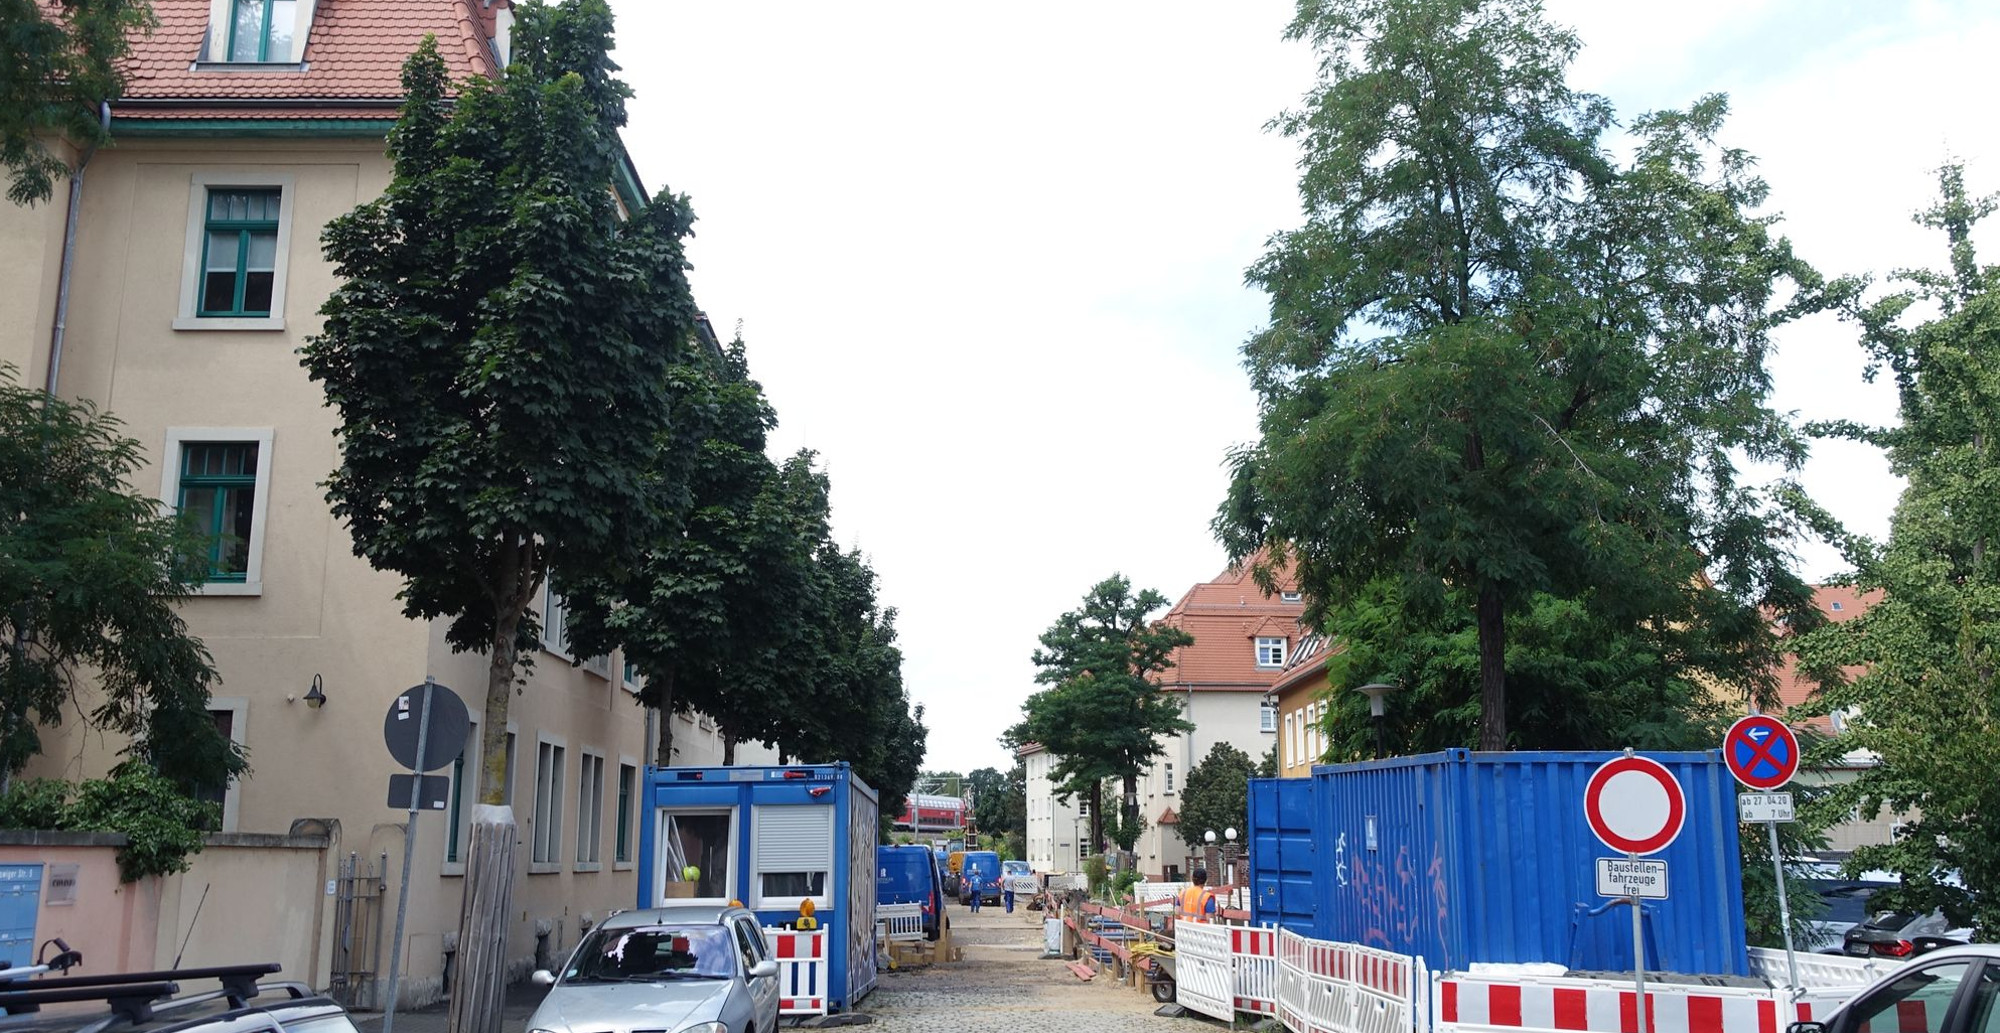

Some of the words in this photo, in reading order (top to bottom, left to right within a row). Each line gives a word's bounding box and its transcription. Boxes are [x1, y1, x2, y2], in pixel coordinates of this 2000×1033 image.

[1742, 797, 1751, 806] ab
[1744, 809, 1753, 818] ab
[1771, 809, 1776, 818] 7
[1778, 809, 1790, 818] Uhr
[1608, 860, 1664, 873] Baustellen-
[1609, 872, 1656, 886] fahrzeuge
[1623, 884, 1640, 896] frei
